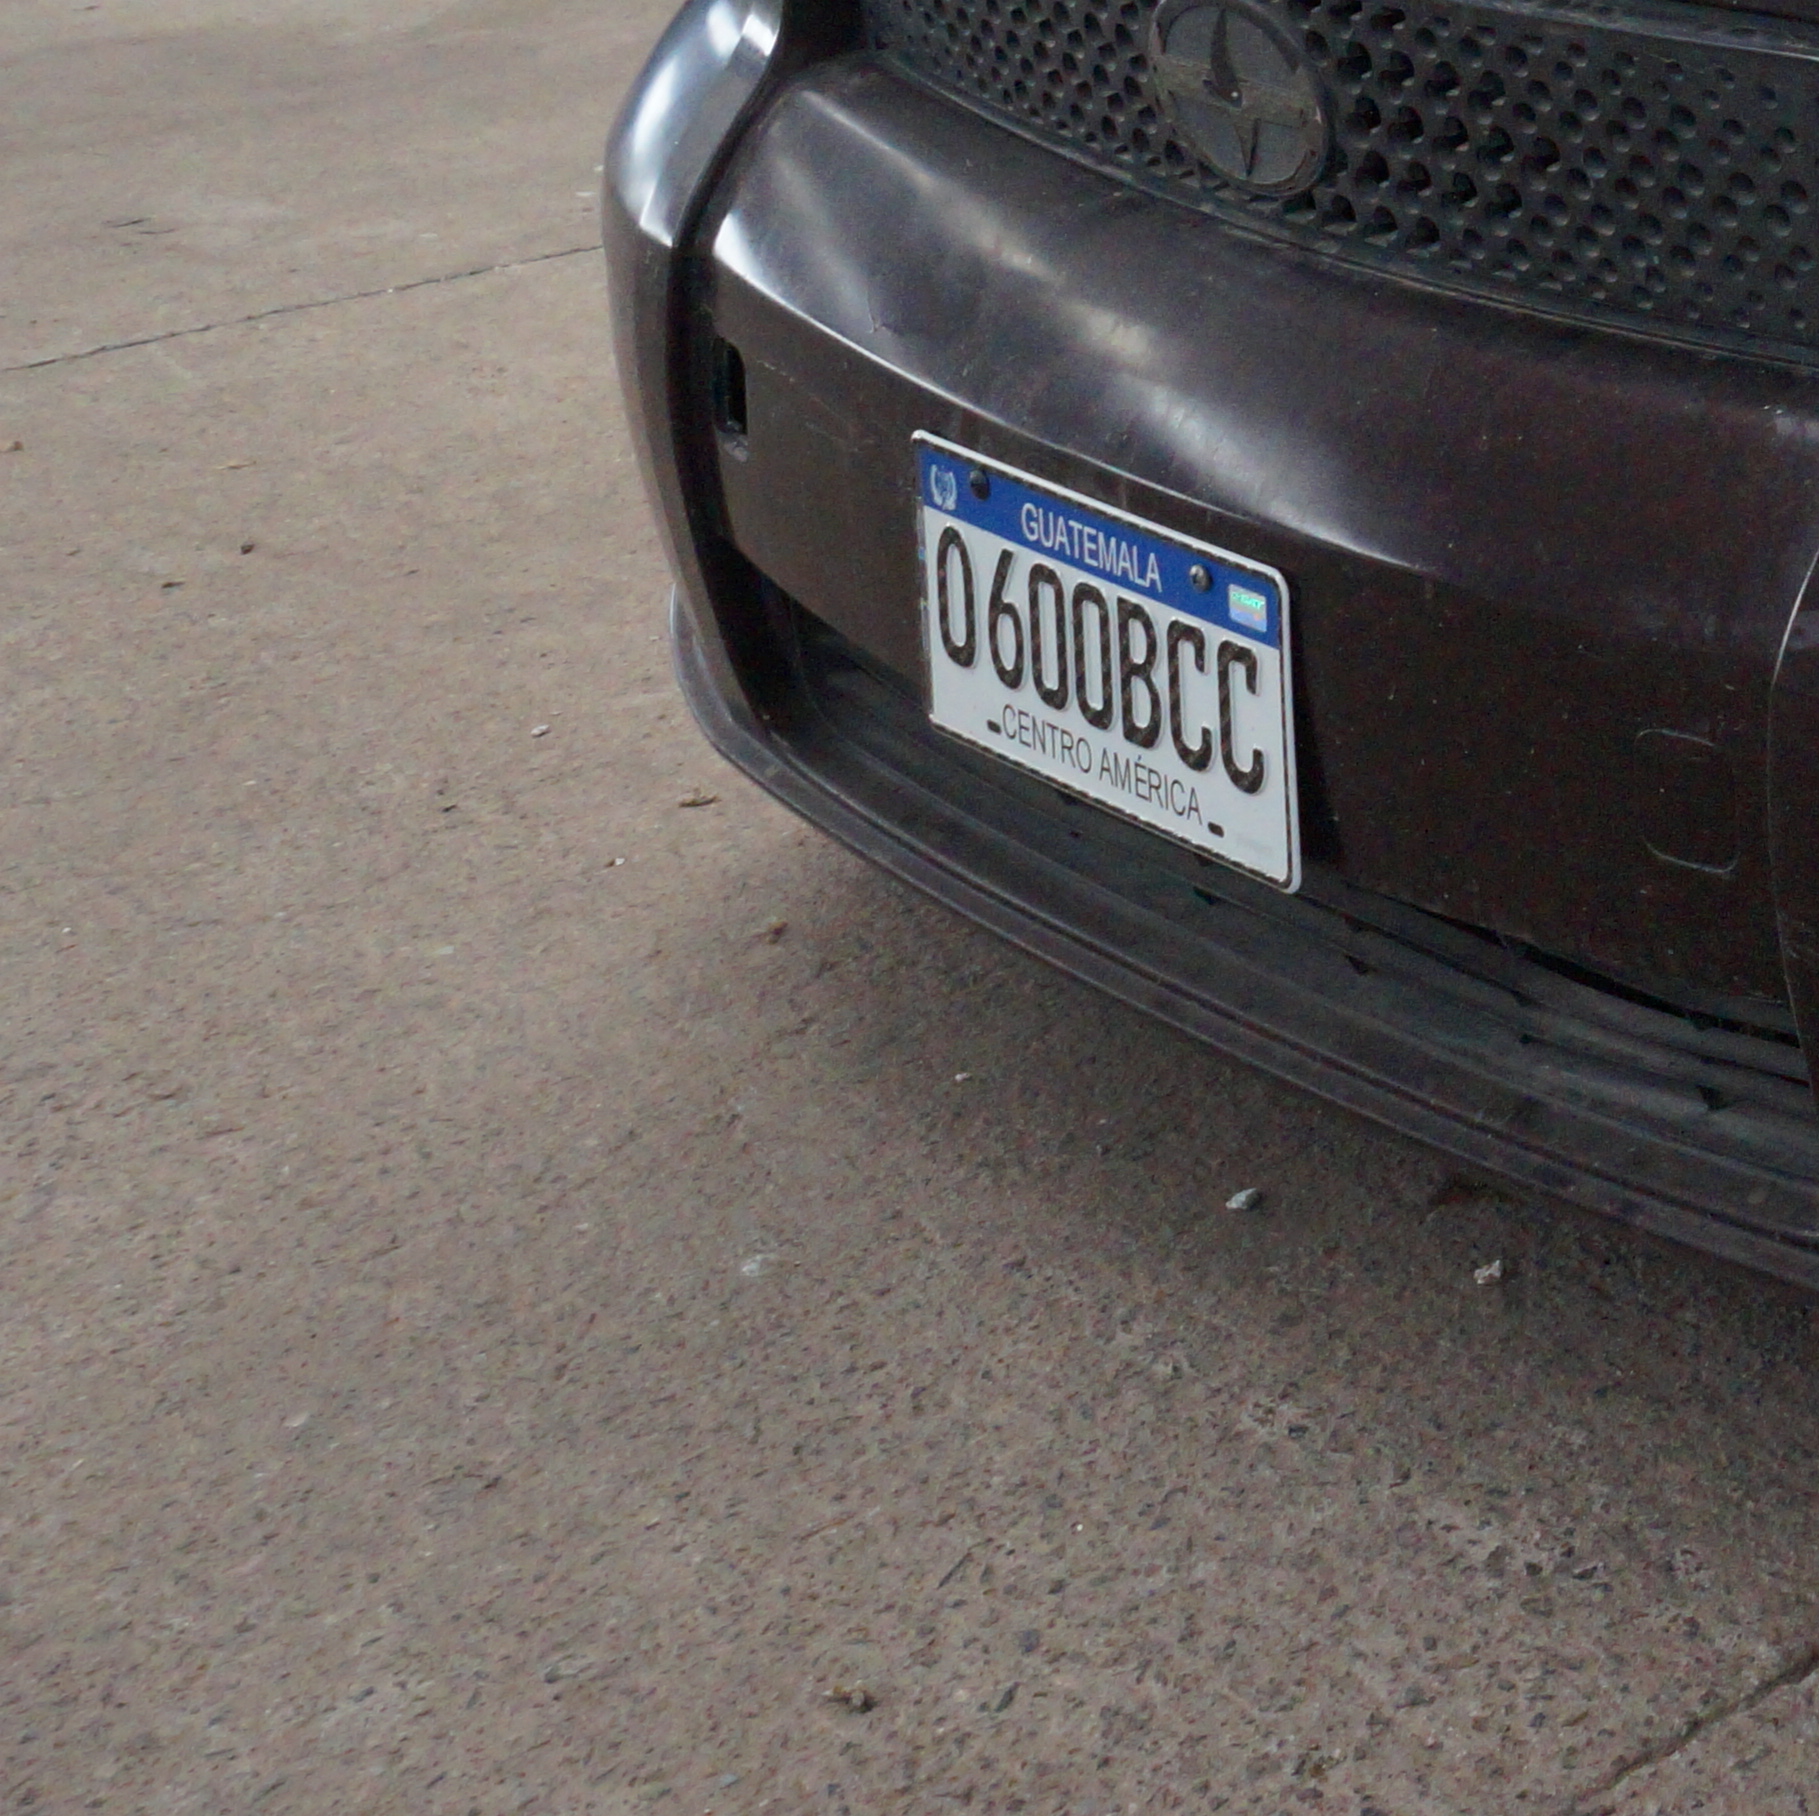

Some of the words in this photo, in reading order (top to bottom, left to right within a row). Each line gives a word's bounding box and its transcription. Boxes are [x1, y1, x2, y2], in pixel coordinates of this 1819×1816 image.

[1021, 502, 1163, 594] GUATEMALA
[1002, 703, 1093, 774] CENTRO
[1099, 754, 1203, 826] AMÉRICA
